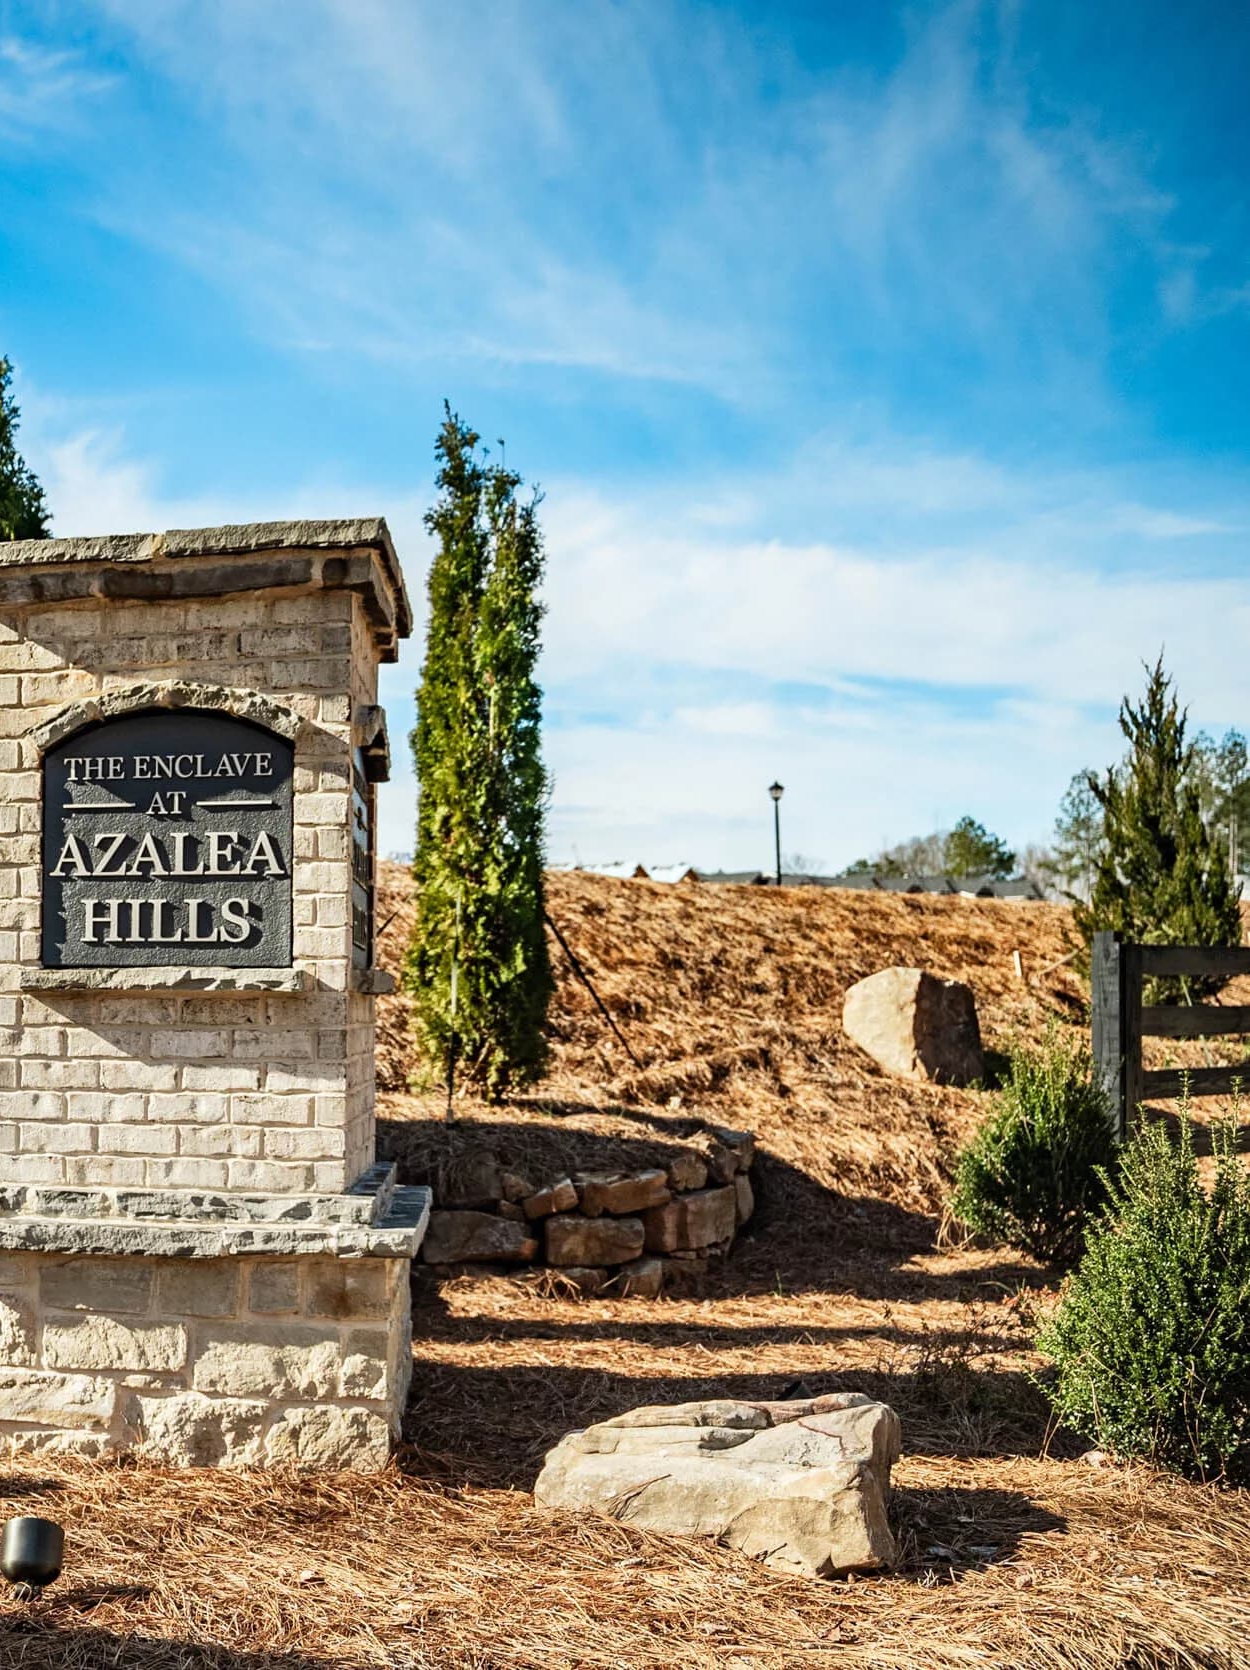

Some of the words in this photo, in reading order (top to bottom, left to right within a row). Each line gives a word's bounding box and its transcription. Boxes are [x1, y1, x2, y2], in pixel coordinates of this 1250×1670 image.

[64, 757, 125, 781] THE
[133, 752, 273, 780] ENCLAVE
[146, 791, 186, 815] AT
[49, 830, 285, 877] AZALEA
[80, 898, 251, 943] HILLS
